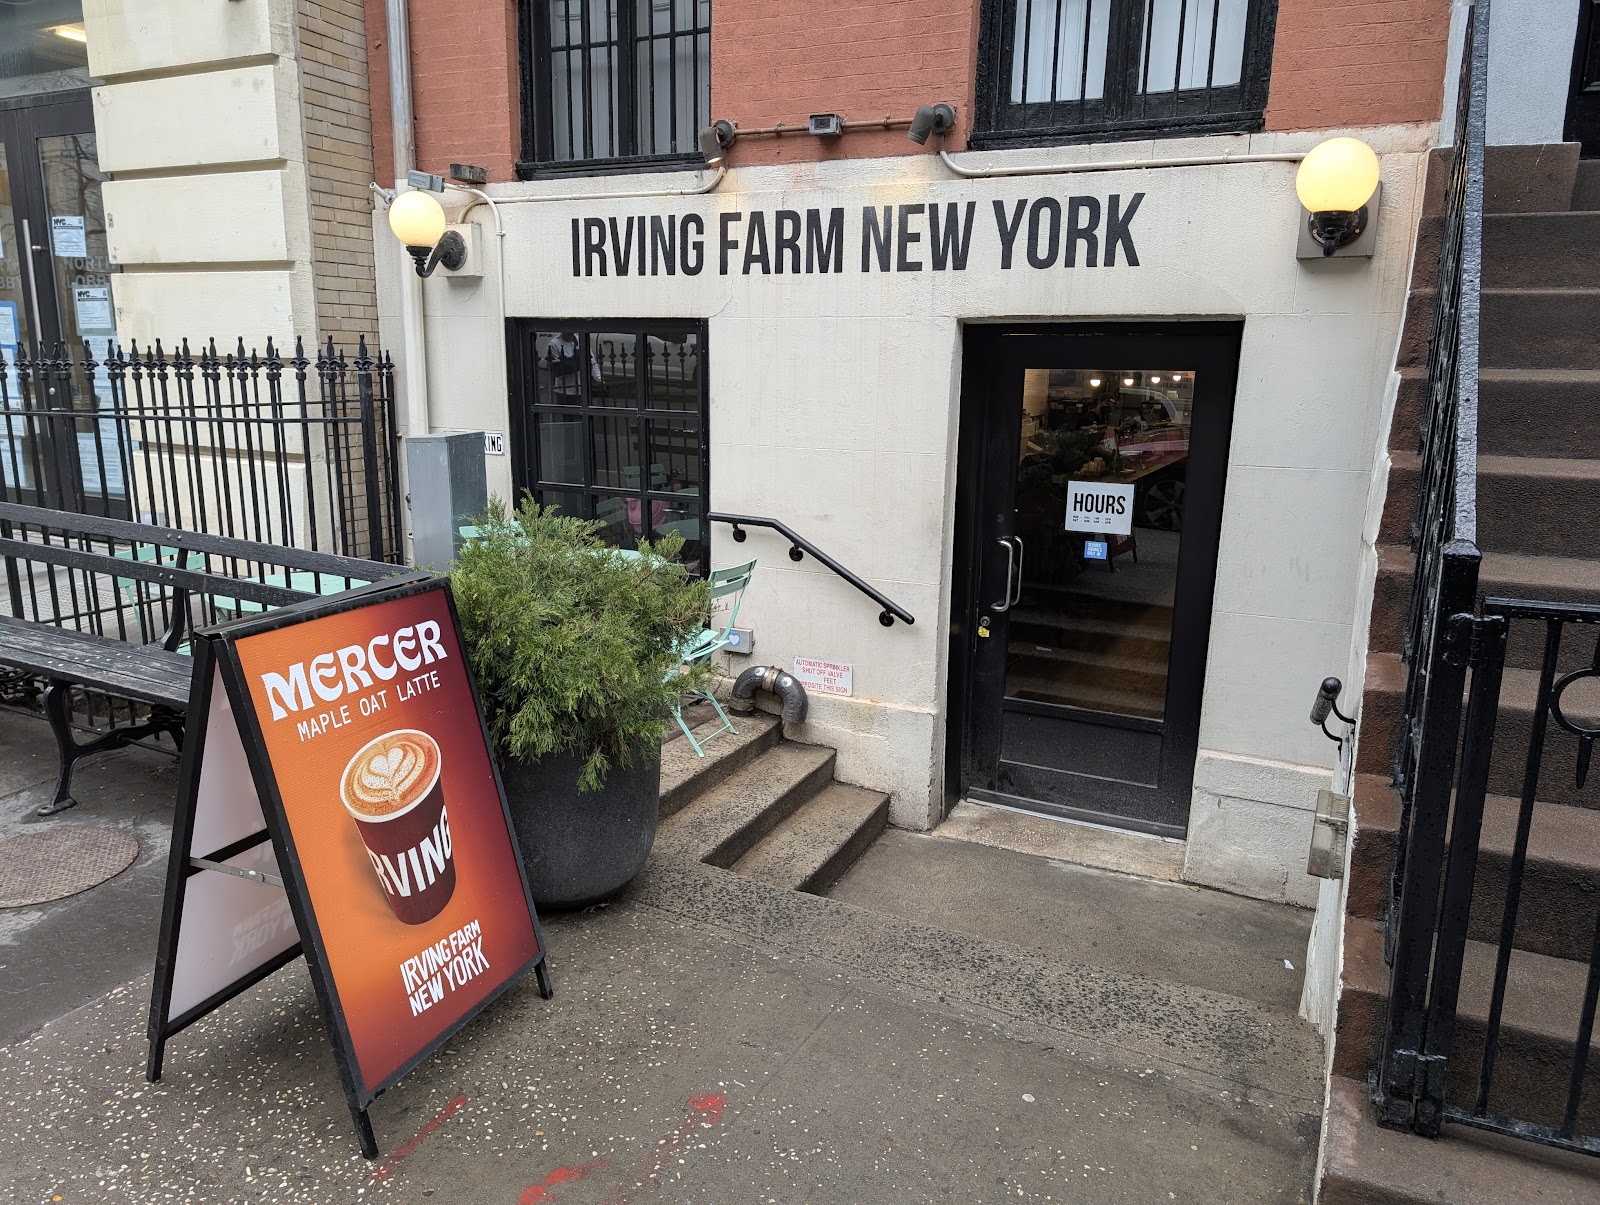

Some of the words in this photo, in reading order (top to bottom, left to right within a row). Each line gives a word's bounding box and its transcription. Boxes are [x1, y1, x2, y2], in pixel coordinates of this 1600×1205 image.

[571, 213, 704, 276] IRVING
[719, 207, 845, 275] FARM
[861, 201, 976, 272] NEW
[992, 192, 1146, 270] YORK
[77, 290, 90, 298] NYC
[1073, 492, 1126, 514] HOURS
[260, 620, 448, 722] MERCER
[796, 659, 822, 668] AUTOMATIC
[824, 662, 850, 672] SPRINKLER
[297, 705, 352, 742] MAPLE
[359, 690, 388, 717] OAT
[396, 670, 441, 702] LATTE
[399, 938, 452, 995] IRVING
[448, 919, 481, 956] FARM
[408, 972, 445, 1017] NEW
[442, 935, 491, 992] YORK
